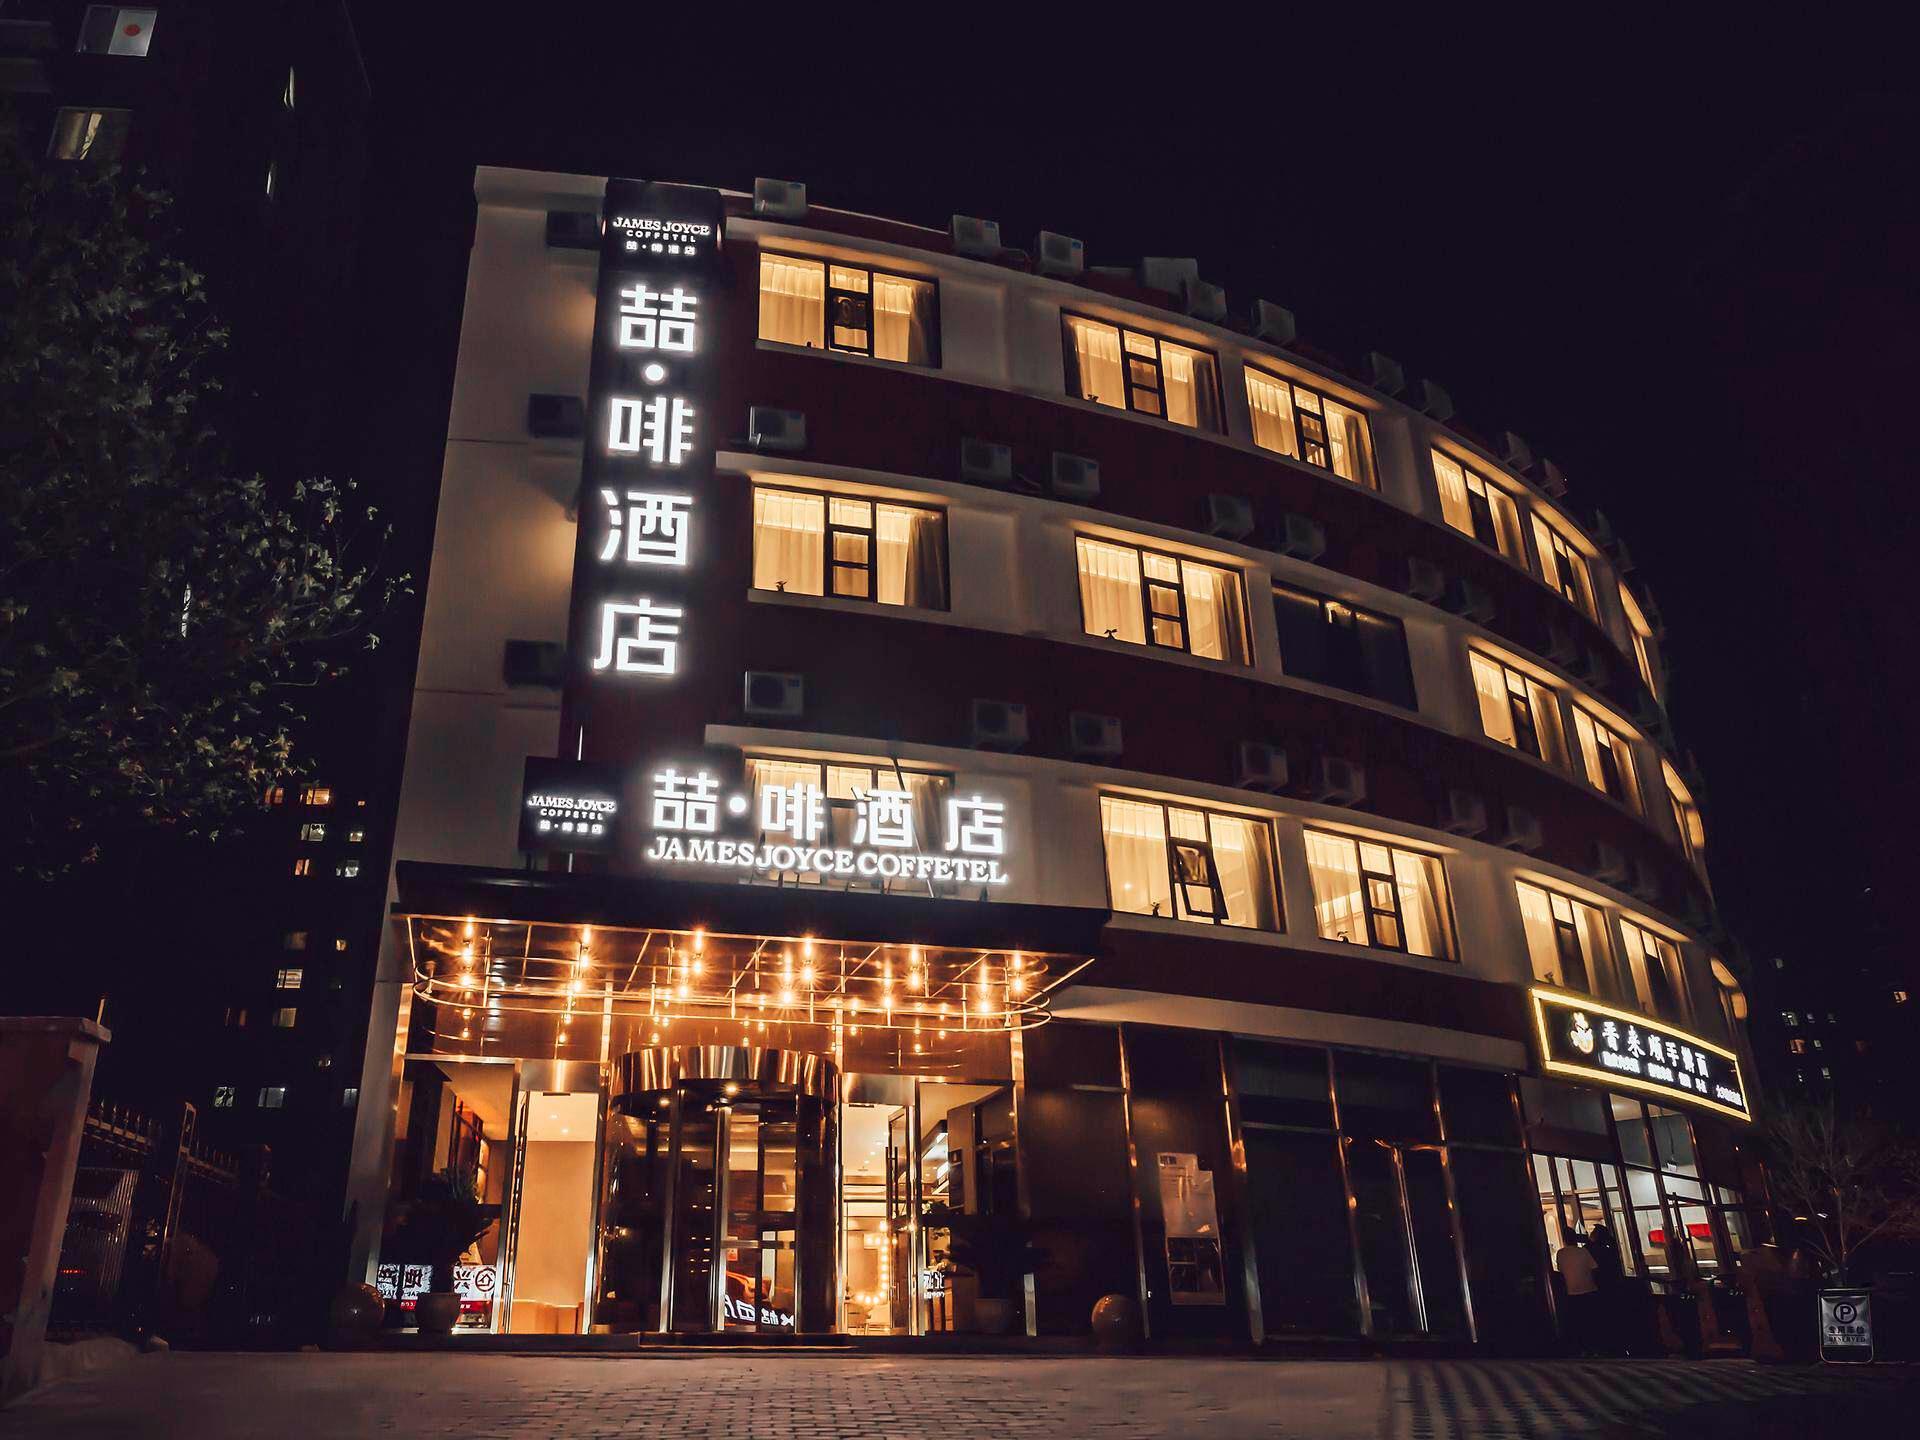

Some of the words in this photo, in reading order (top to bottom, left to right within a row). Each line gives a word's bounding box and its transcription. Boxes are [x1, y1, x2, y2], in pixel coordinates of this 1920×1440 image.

[612, 216, 662, 231] JAMES
[662, 221, 711, 236] JOYCE
[626, 229, 696, 243] COFFETEL
[527, 795, 574, 809] JAMES
[574, 799, 616, 812] JOYCE
[648, 835, 755, 866] JAMES
[755, 844, 856, 873] JOYCE
[857, 851, 1009, 884] COFFETEL
